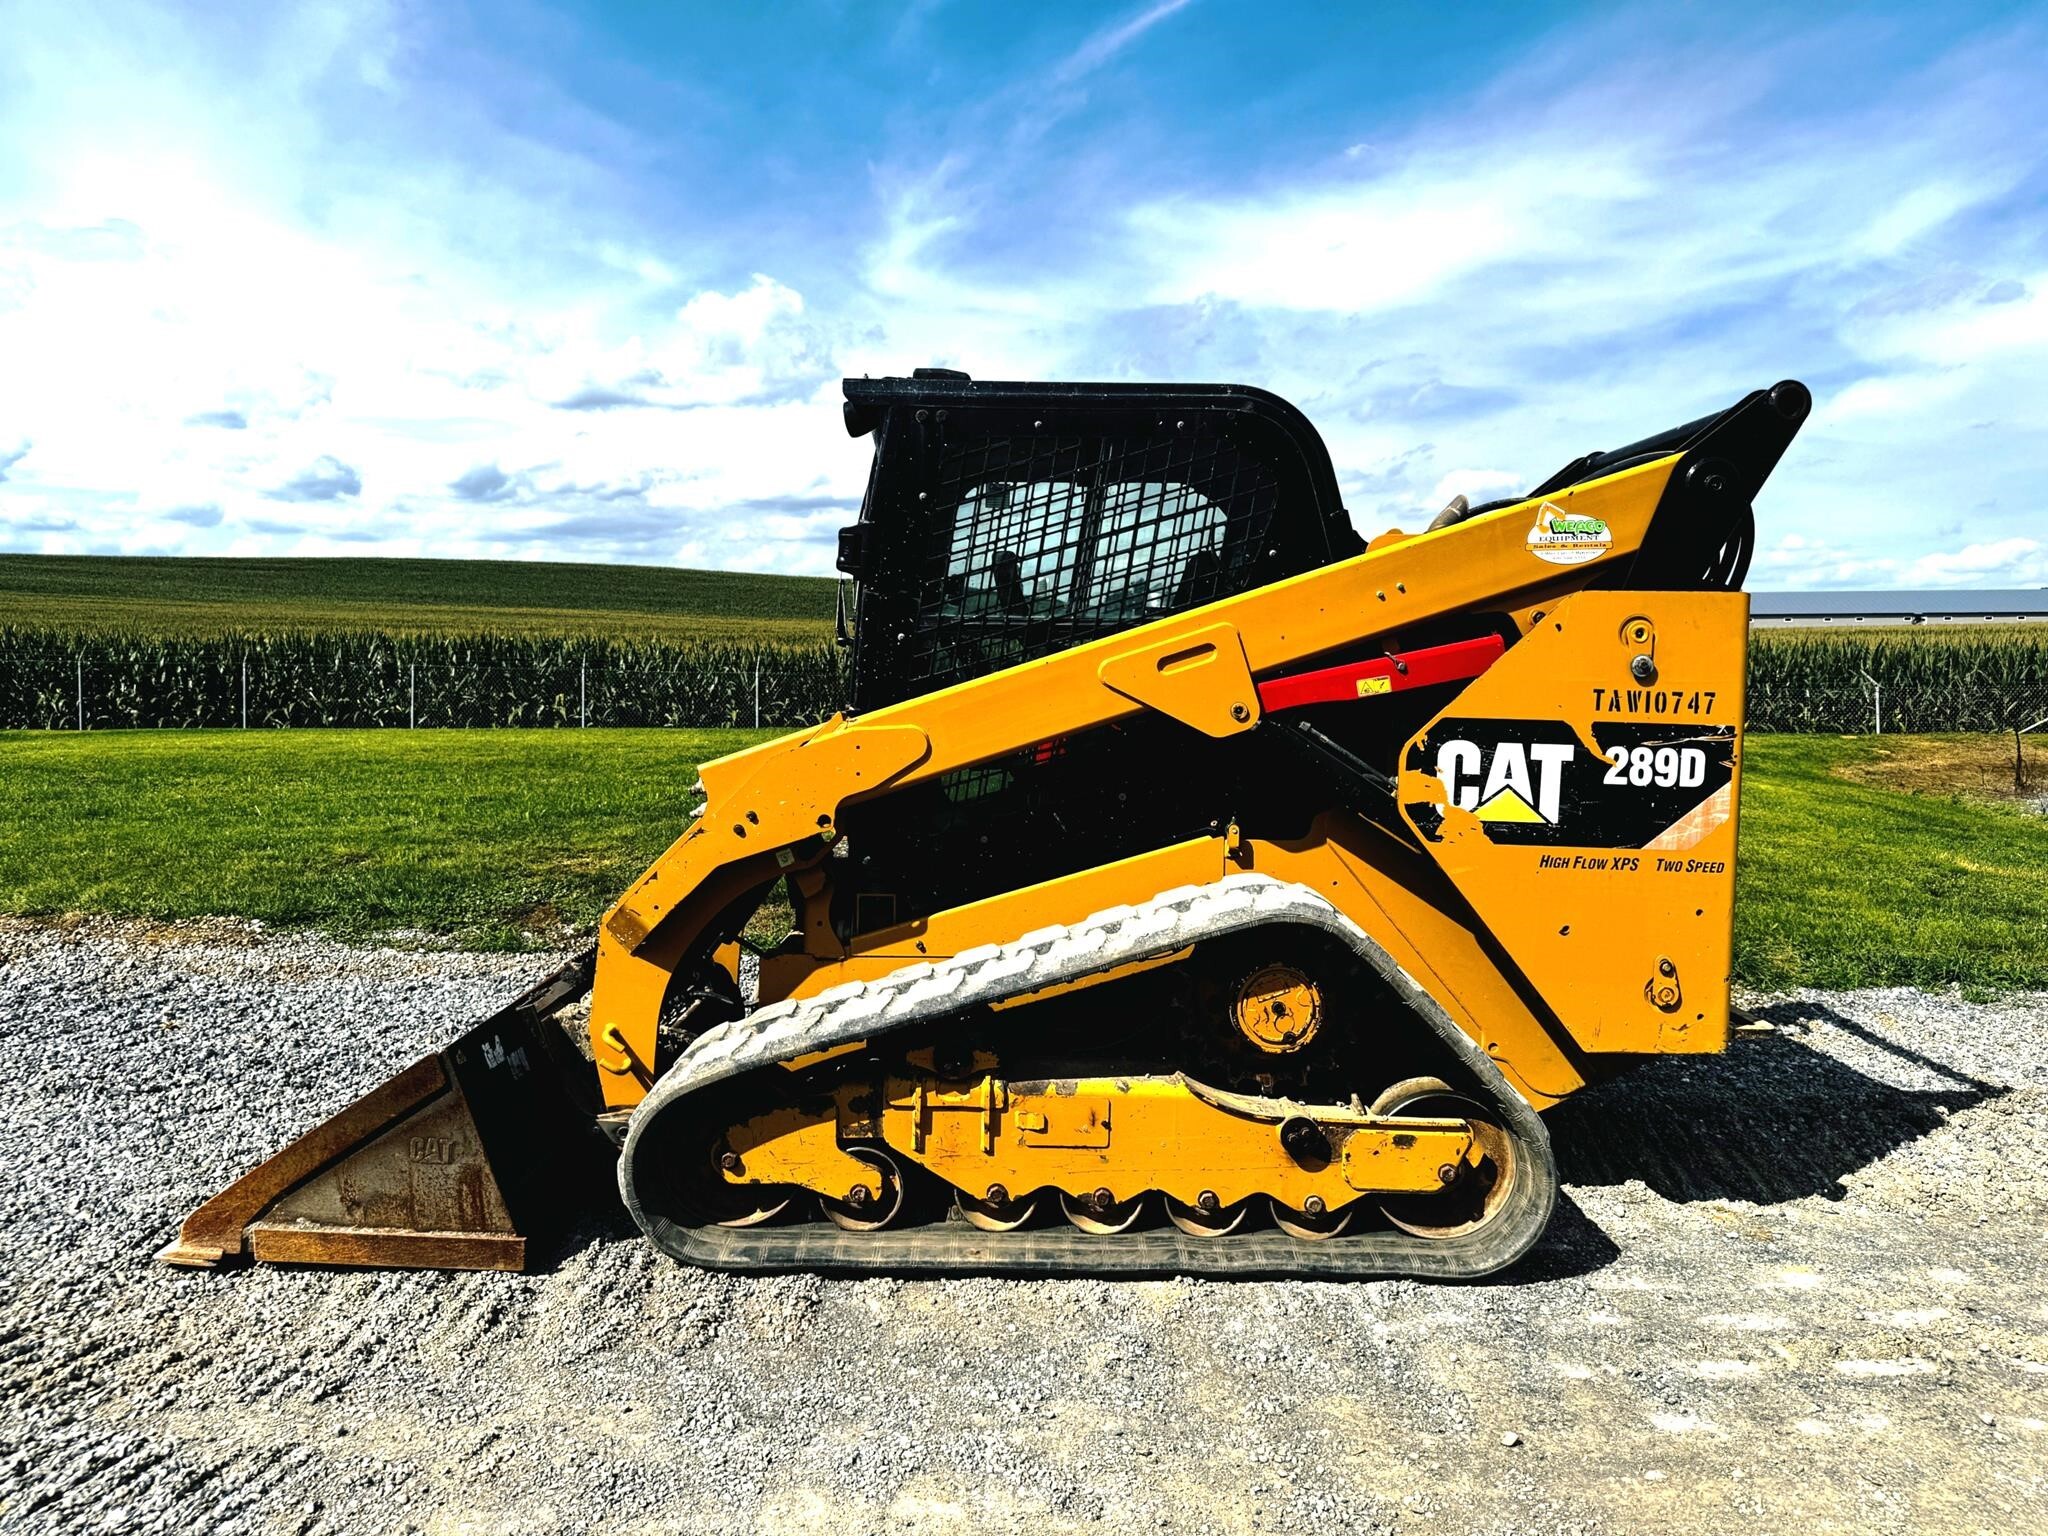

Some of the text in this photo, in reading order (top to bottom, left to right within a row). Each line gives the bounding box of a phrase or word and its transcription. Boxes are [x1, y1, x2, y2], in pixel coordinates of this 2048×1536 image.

[1539, 535, 1599, 543] EQUIPMENT
[1603, 746, 1706, 788] 289D
[1436, 740, 1575, 825] CAT
[1539, 854, 1640, 872] HIGH FLOW XPS
[1656, 858, 1725, 874] TWO SPEED
[409, 1136, 456, 1164] CAT
